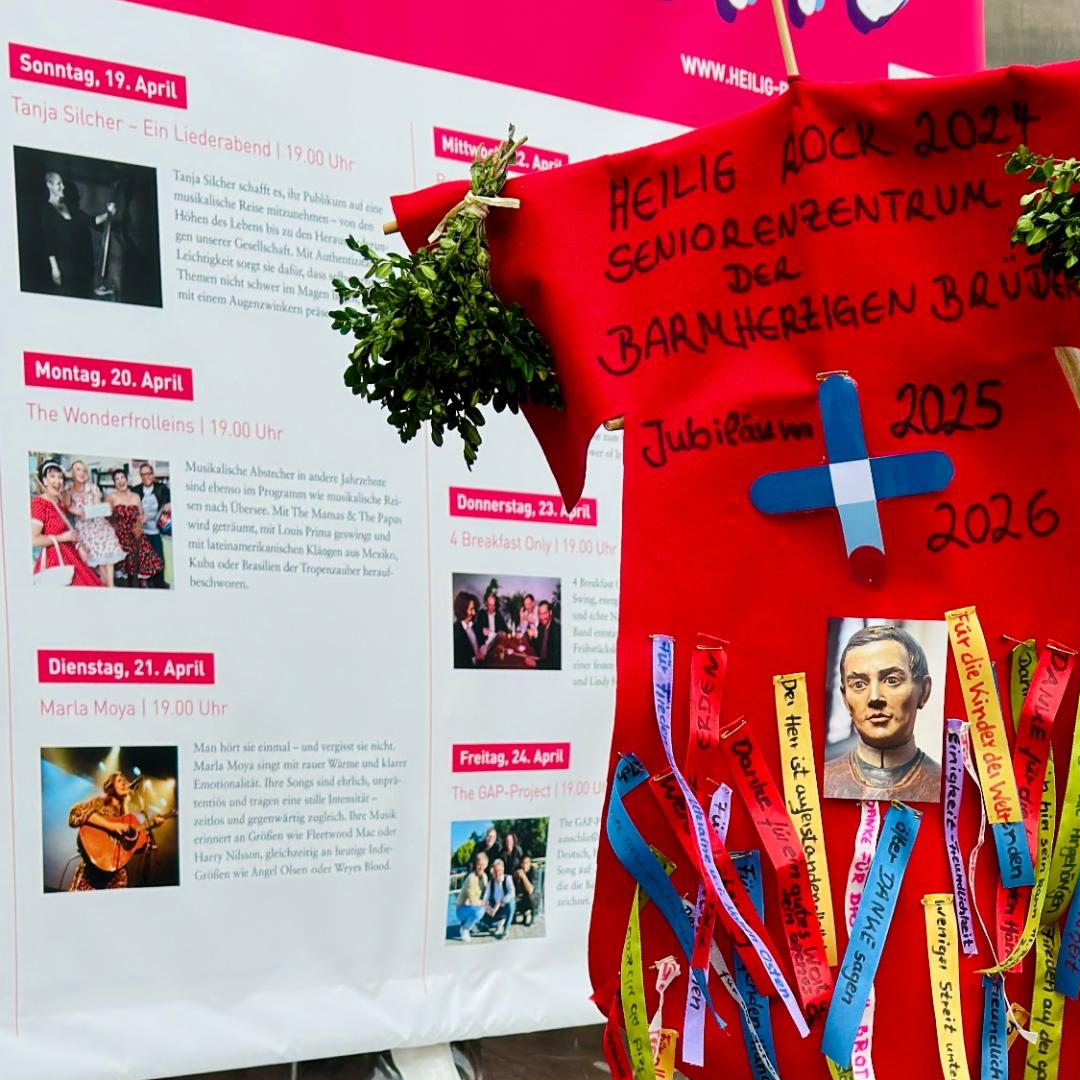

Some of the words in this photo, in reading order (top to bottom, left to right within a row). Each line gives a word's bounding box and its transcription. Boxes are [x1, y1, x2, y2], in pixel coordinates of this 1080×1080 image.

[19, 53, 101, 88] Sonntag,
[105, 69, 131, 91] 19.
[135, 75, 178, 100] April
[11, 95, 58, 124] Tanja
[63, 104, 124, 131] Silcher
[143, 118, 169, 139] Ein
[174, 123, 271, 157] Liederabend
[286, 144, 324, 166] 19.00
[328, 153, 356, 172] Uhr
[608, 150, 737, 232] HEILIG
[780, 123, 895, 184] ROCK
[913, 100, 1041, 160] 2024
[172, 168, 201, 186] Tanja
[203, 173, 236, 191] Silcher
[238, 180, 271, 196] schafft
[273, 188, 286, 200] es,
[287, 189, 301, 201] ihr
[303, 190, 347, 209] Publikum
[349, 198, 364, 212] auf
[366, 203, 384, 215] eine
[604, 179, 1004, 284] SENIORENZENTRUM
[723, 254, 802, 295] DER
[596, 284, 917, 376] BARMHERZIGEN
[35, 360, 107, 388] Montag,
[110, 368, 137, 387] 20.
[141, 371, 184, 393] April
[26, 402, 58, 423] The
[63, 406, 195, 433] Wonderfrolleins
[210, 419, 250, 438] 19.00
[255, 424, 284, 441] Uhr
[889, 379, 1007, 440] 2025
[641, 410, 815, 468] Jubiläum
[185, 460, 248, 477] Musikalische
[249, 465, 295, 481] Abstecher
[308, 470, 339, 484] andere
[339, 473, 387, 488] Jahrzehnte
[456, 493, 536, 518] Donnerstag,
[538, 501, 557, 516] 23.
[926, 488, 1060, 553] 2026
[450, 529, 458, 545] 4
[461, 531, 521, 551] Breakfast
[525, 536, 552, 555] Only
[563, 539, 593, 554] 19.00
[596, 541, 618, 556] Uhr
[952, 611, 971, 648] Für
[48, 657, 130, 680] Dienstag,
[134, 659, 160, 677] 21.
[163, 660, 206, 680] April
[960, 652, 980, 681] die
[40, 699, 89, 716] Marla
[94, 700, 136, 720] Moya
[153, 700, 194, 716] 19.00
[199, 700, 229, 716] Uhr
[969, 682, 997, 748] Kinder
[193, 741, 218, 754] Man
[219, 741, 240, 753] hört
[242, 741, 256, 752] sie
[257, 740, 291, 753] einmal
[460, 750, 509, 767] Freitag,
[511, 750, 531, 764] 24.
[533, 749, 564, 766] April
[789, 755, 811, 781] ist
[982, 752, 1003, 784] der
[452, 785, 475, 801] The
[478, 783, 551, 803] GAP-Project
[562, 782, 590, 796] 19.00
[989, 782, 1012, 823] Welt
[850, 852, 872, 884] FÜR
[1039, 838, 1049, 874] sein
[858, 864, 896, 951] DANKE
[758, 948, 791, 1000] Osten
[841, 950, 867, 1006] sagen
[938, 980, 957, 1034] Streit
[1033, 998, 1055, 1030] auf
